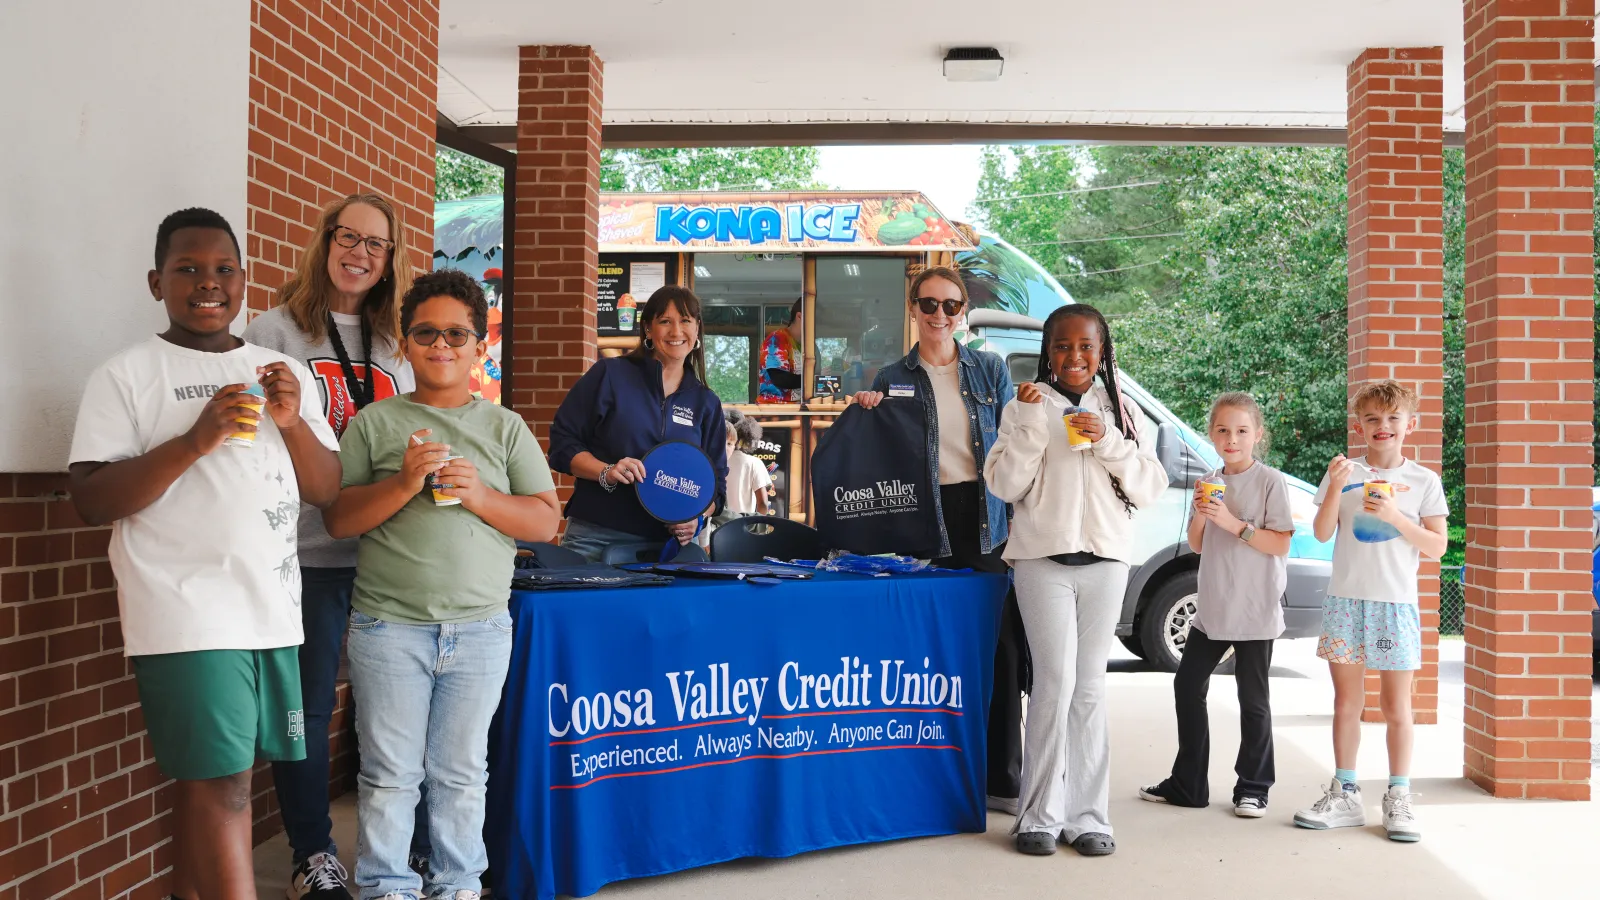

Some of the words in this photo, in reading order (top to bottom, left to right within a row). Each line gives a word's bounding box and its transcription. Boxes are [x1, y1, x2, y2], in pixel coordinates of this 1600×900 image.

[656, 206, 781, 245] KONA
[786, 204, 861, 242] ICE
[597, 267, 624, 275] BLEND
[656, 469, 678, 485] Coosa
[680, 476, 701, 492] Valley
[834, 486, 875, 503] Coosa
[875, 480, 916, 498] Valley
[835, 501, 875, 512] CREDIT
[881, 497, 918, 507] UNION
[548, 682, 656, 738] Coosa
[665, 662, 769, 726] Valley
[778, 656, 873, 712] Credit
[880, 656, 963, 709] Union
[570, 739, 683, 778] Experienced.
[694, 733, 751, 757] Always
[757, 726, 818, 751] Nearby.
[828, 722, 883, 748] Anyone
[886, 719, 913, 740] Can
[916, 719, 945, 744] Join.
